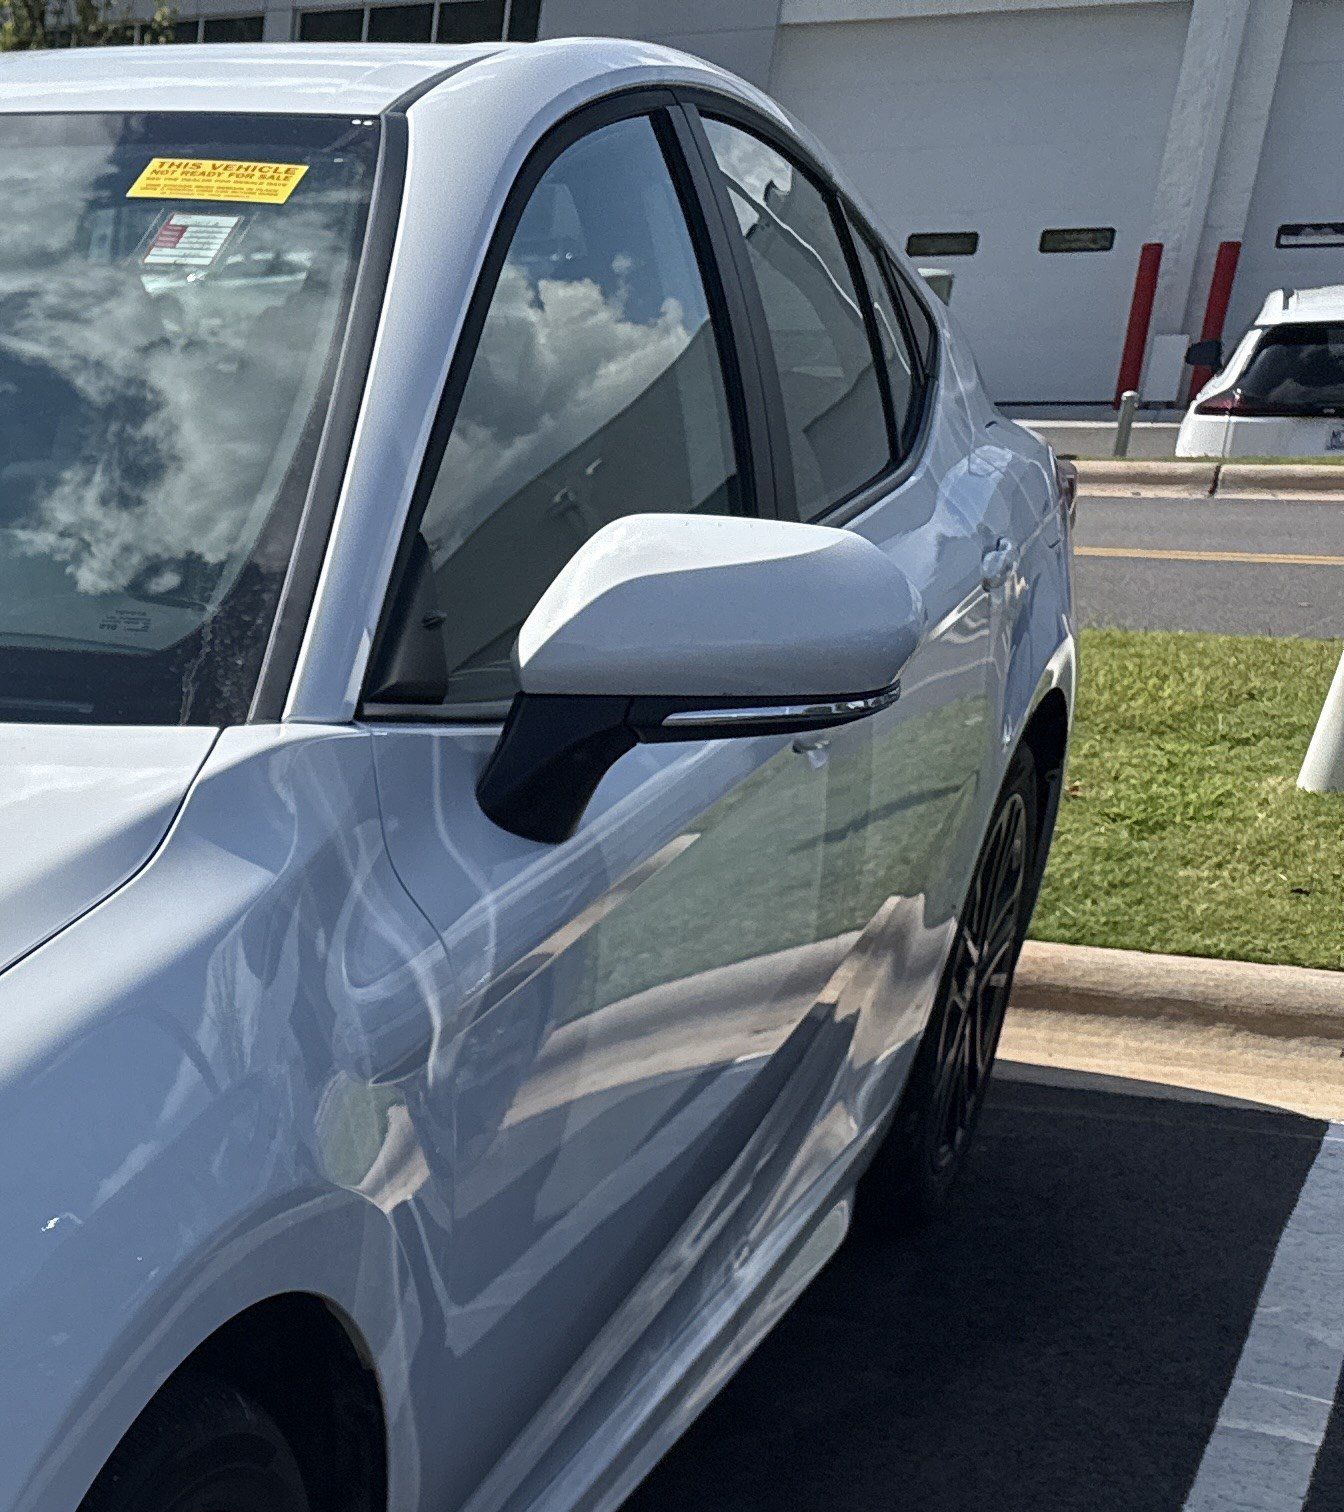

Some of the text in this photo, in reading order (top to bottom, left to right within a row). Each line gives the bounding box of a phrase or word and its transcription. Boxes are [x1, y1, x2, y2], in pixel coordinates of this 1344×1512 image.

[158, 161, 300, 176] THIS VEHICLE
[179, 170, 225, 178] READY
[227, 172, 256, 180] FOR
[258, 174, 293, 182] SALE
